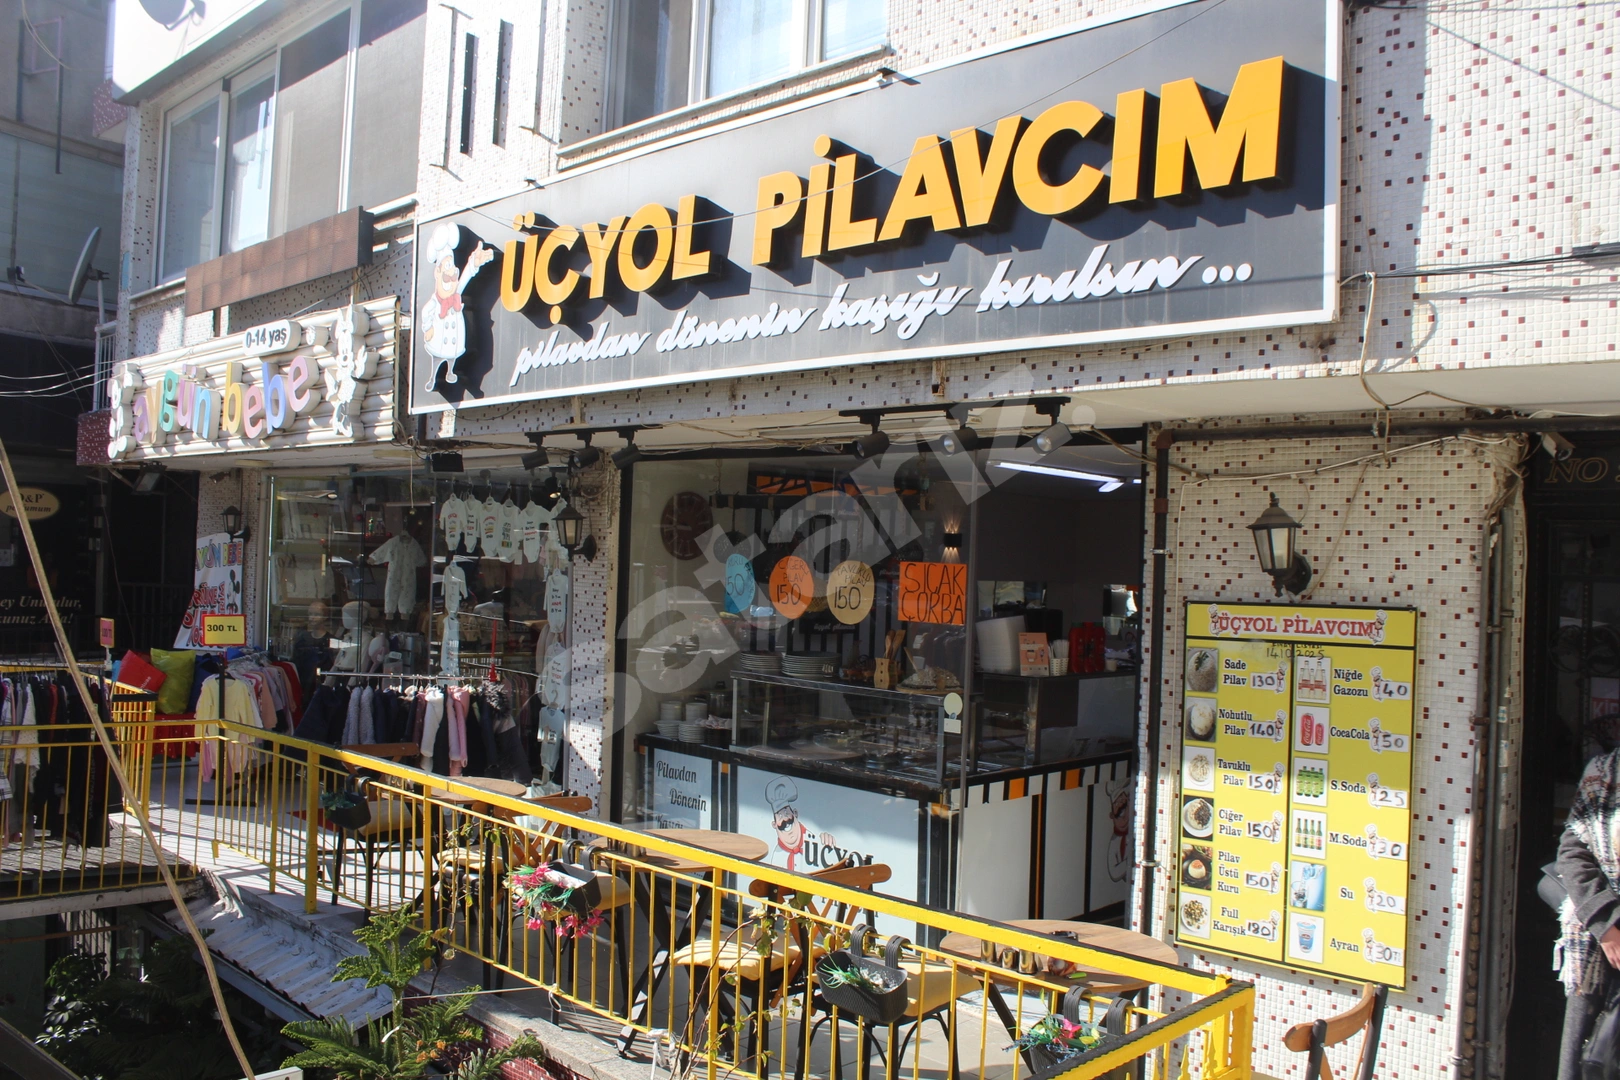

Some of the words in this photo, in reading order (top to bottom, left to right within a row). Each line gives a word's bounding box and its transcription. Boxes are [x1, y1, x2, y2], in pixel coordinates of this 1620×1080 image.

[500, 194, 711, 325] ÜÇYOL
[751, 54, 1284, 266] PİLAVCIM
[245, 331, 267, 349] 0-14
[268, 326, 288, 348] yaş
[509, 321, 651, 387] pilavdan
[656, 301, 817, 353] dönenin
[818, 271, 972, 341] kaşığı
[133, 364, 212, 444] aygün
[222, 355, 311, 439] bebe
[1544, 456, 1609, 484] NO
[223, 541, 243, 567] BEBE
[904, 562, 965, 596] SICAK
[776, 583, 802, 605] 150
[834, 586, 861, 610] 150
[19, 596, 82, 610] Unuulur,
[900, 592, 965, 625] ÇORBA
[207, 624, 225, 632] 300
[1218, 612, 1277, 635] ÜÇYOL
[1283, 614, 1375, 638] PİLAVCIM
[1224, 658, 1246, 670] Sade
[1223, 674, 1247, 686] Pilav
[1252, 675, 1275, 687] 130
[1333, 668, 1363, 681] Niğde
[1333, 685, 1369, 697] Gazozu
[1382, 683, 1408, 697] 40
[1218, 708, 1253, 722] Nohutlu
[1224, 725, 1246, 736] Pilav
[1249, 723, 1275, 736] 140
[1381, 734, 1404, 748] 50
[656, 760, 697, 784] Pilavdan
[1217, 758, 1251, 772] Tavuklu
[1223, 775, 1244, 787] Pilav
[1248, 775, 1274, 790] 150
[669, 787, 707, 812] Dönenin
[1330, 781, 1367, 794] S.Soda
[1379, 790, 1405, 807] 25
[1218, 809, 1243, 822] Ciğer
[1218, 825, 1242, 837] Pilav
[1247, 822, 1272, 839] 150
[1329, 832, 1368, 848] M.Soda
[1377, 841, 1402, 857] 30
[1218, 851, 1241, 864] Pilav
[1218, 864, 1239, 879] Üstü
[1217, 882, 1240, 894] Kuru
[1245, 873, 1269, 888] 150
[1340, 888, 1354, 900] Su
[1376, 894, 1397, 908] 20
[1220, 907, 1239, 919] Full
[1212, 920, 1247, 937] Karışık
[1247, 922, 1271, 937] 180
[1329, 938, 1360, 953] Ayran
